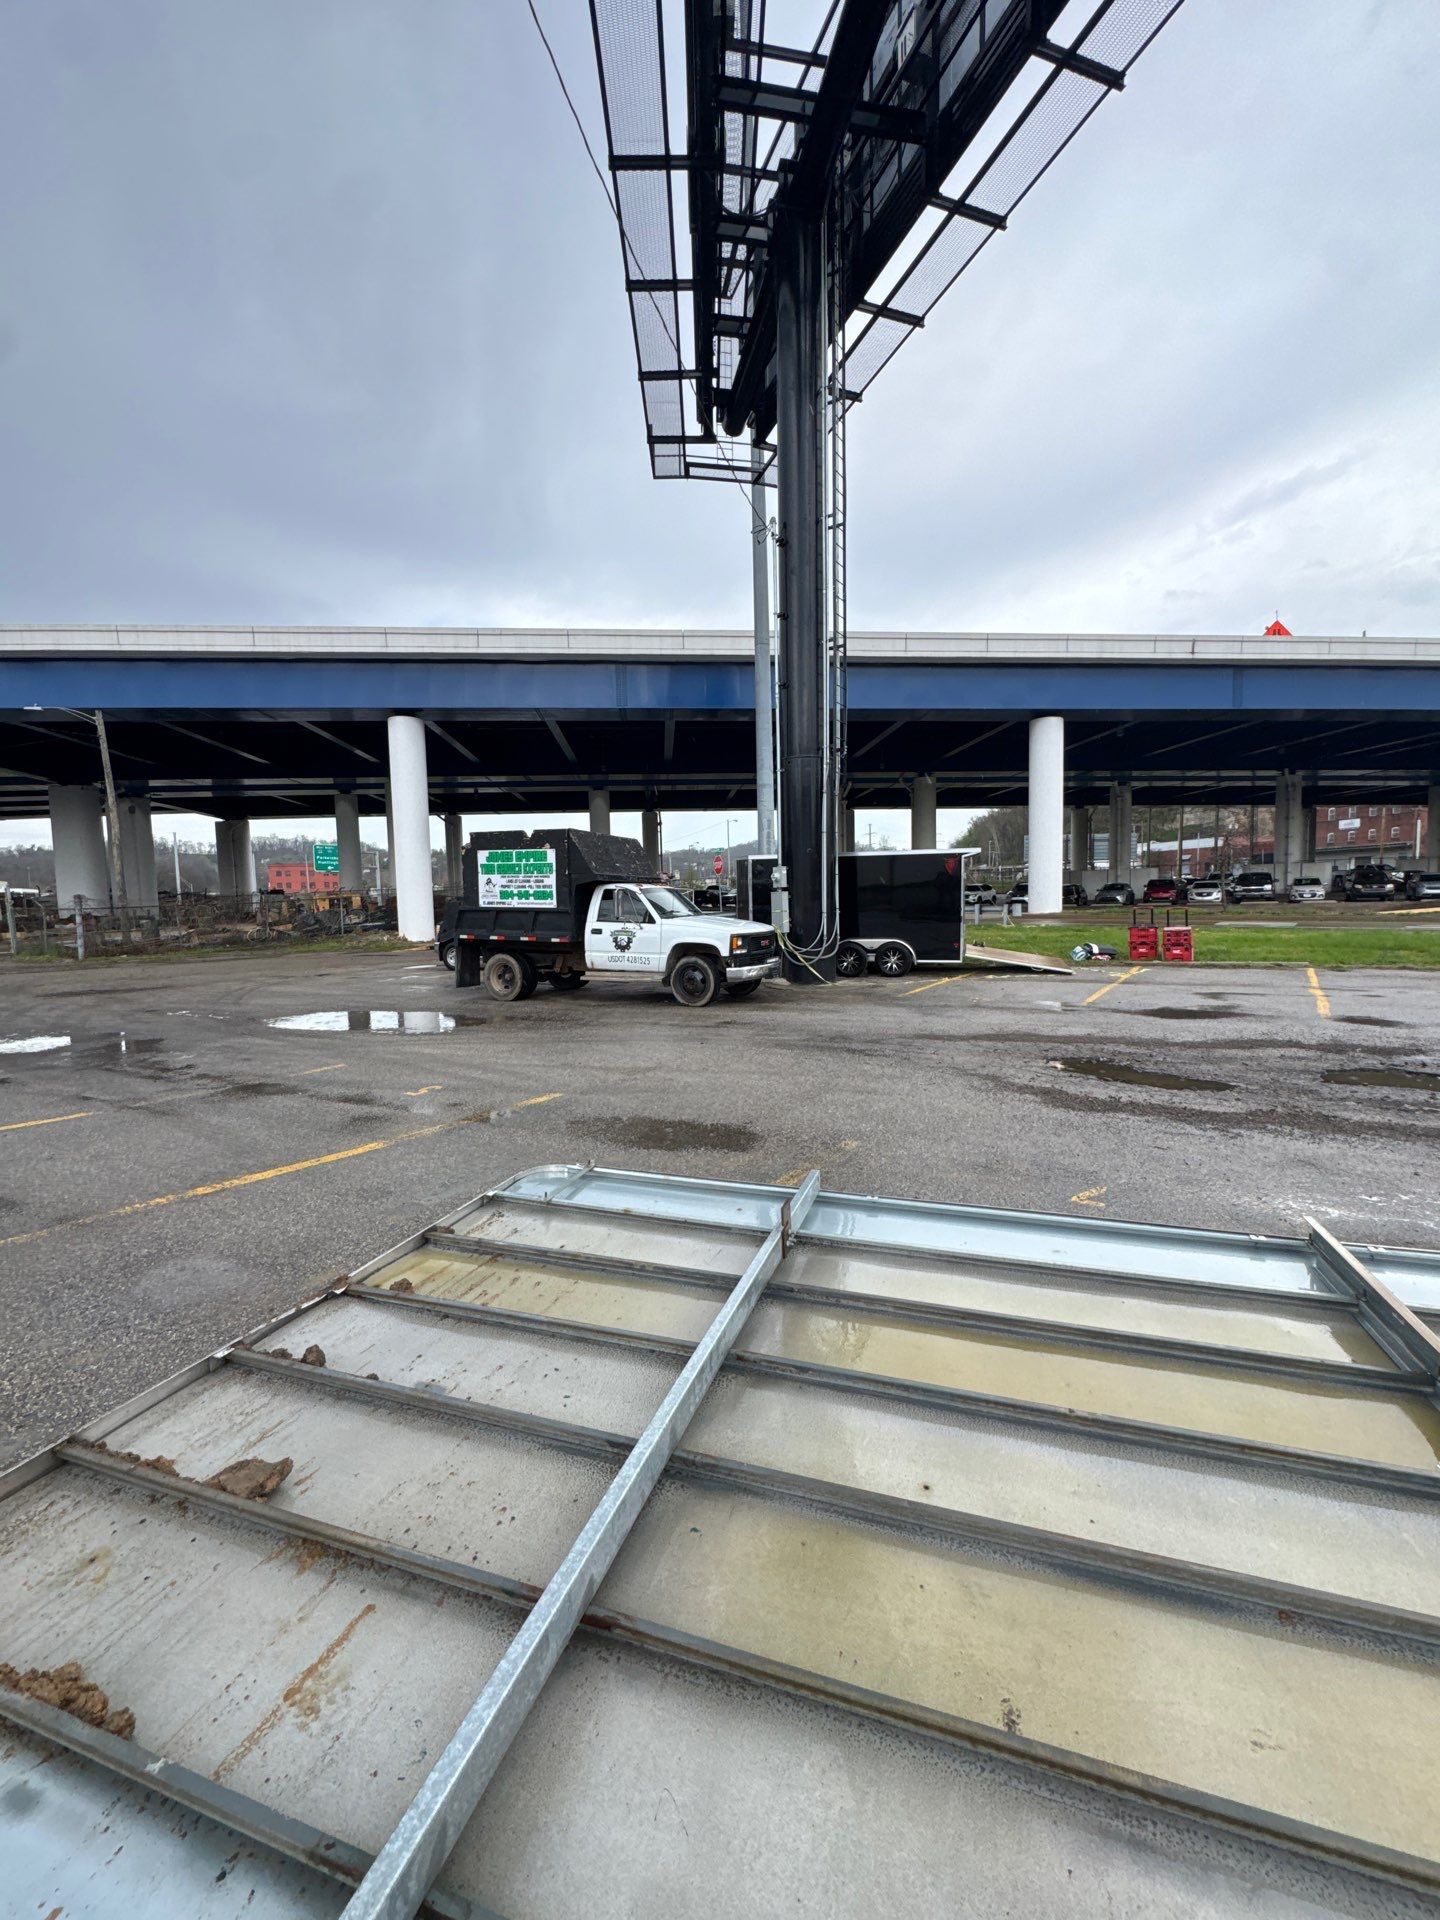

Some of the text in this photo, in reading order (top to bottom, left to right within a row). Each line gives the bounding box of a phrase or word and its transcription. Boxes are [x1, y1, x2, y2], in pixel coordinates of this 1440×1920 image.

[515, 850, 547, 862] EMPIRE
[480, 863, 553, 875] TREE SERVICE EXPERTS
[608, 955, 651, 965] USDOT 4281525
